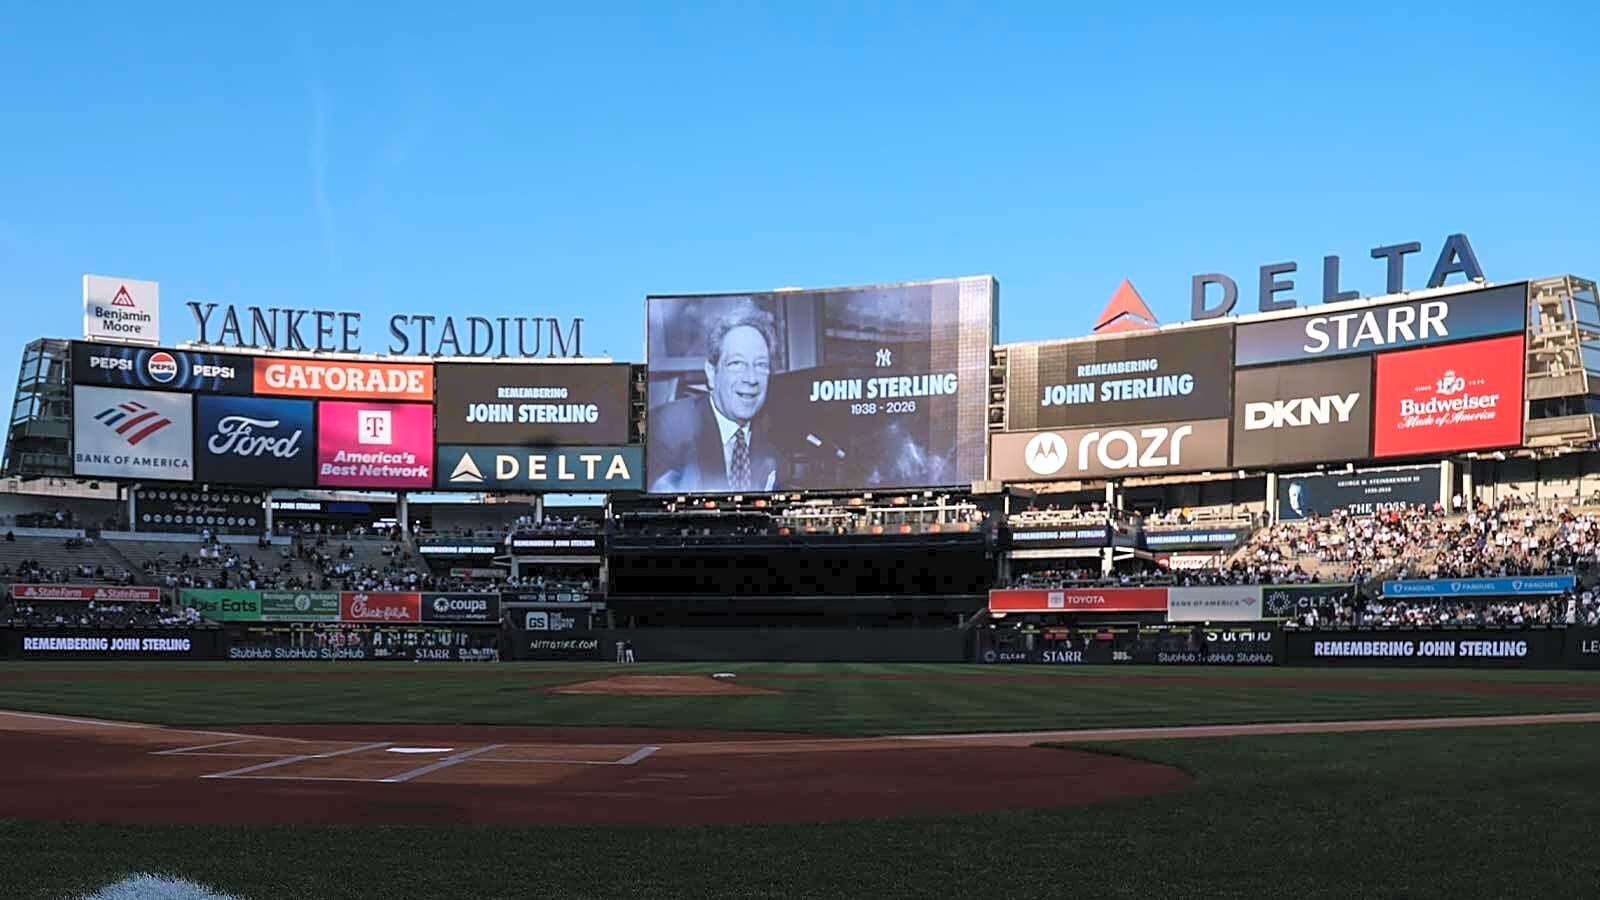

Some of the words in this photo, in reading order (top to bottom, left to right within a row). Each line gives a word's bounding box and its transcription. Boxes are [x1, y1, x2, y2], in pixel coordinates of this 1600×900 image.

[1190, 233, 1486, 320] DELTA
[95, 306, 151, 322] Benjamin
[103, 320, 142, 333] Moore
[186, 300, 361, 353] YANKEE
[388, 313, 584, 358] STADIUM
[1303, 301, 1449, 353] STARR
[90, 356, 133, 370] PEPSI
[151, 363, 175, 371] PEPSI
[1078, 359, 1158, 377] REMEMBERING
[193, 365, 235, 379] PEPSI
[265, 364, 424, 393] GATORADE
[498, 387, 568, 399] REMEMBERING
[810, 379, 862, 401] JOHN
[867, 373, 958, 399] STERLING
[1041, 383, 1095, 406] JOHN
[1100, 374, 1194, 402] STERLING
[851, 403, 877, 415] 1938
[886, 401, 916, 413] 2026
[1244, 393, 1360, 430] DKNY
[1400, 393, 1500, 417] Budweiser
[466, 404, 513, 423] JOHN
[518, 404, 599, 423] STERLING
[1397, 415, 1433, 429] Made
[1435, 413, 1449, 427] of
[1449, 410, 1497, 425] America
[208, 416, 302, 458] Ford
[1078, 425, 1192, 471] razr
[76, 454, 111, 463] BANK
[114, 456, 130, 464] OF
[133, 457, 190, 468] AMERICA
[335, 450, 416, 464] America's
[321, 463, 357, 475] Best
[360, 464, 429, 477] Network
[496, 454, 630, 480] DELTA
[1348, 503, 1372, 514] THE
[221, 598, 257, 612] Eats
[450, 600, 487, 613] coupa
[1067, 596, 1105, 604] TOYOTA
[529, 617, 545, 628] GS
[24, 637, 108, 650] REMEMBERING
[110, 638, 140, 650] JOHN
[142, 638, 191, 651] STERLING
[1314, 641, 1413, 656] REMEMBERING
[1416, 641, 1455, 656] JOHN
[1459, 641, 1527, 656] STERLING
[230, 648, 272, 659] StubHub
[275, 648, 317, 659] StubHub
[416, 649, 450, 659] STARR
[1042, 651, 1082, 662] STARR
[1158, 652, 1195, 662] StubHub
[1237, 652, 1273, 662] StubHub
